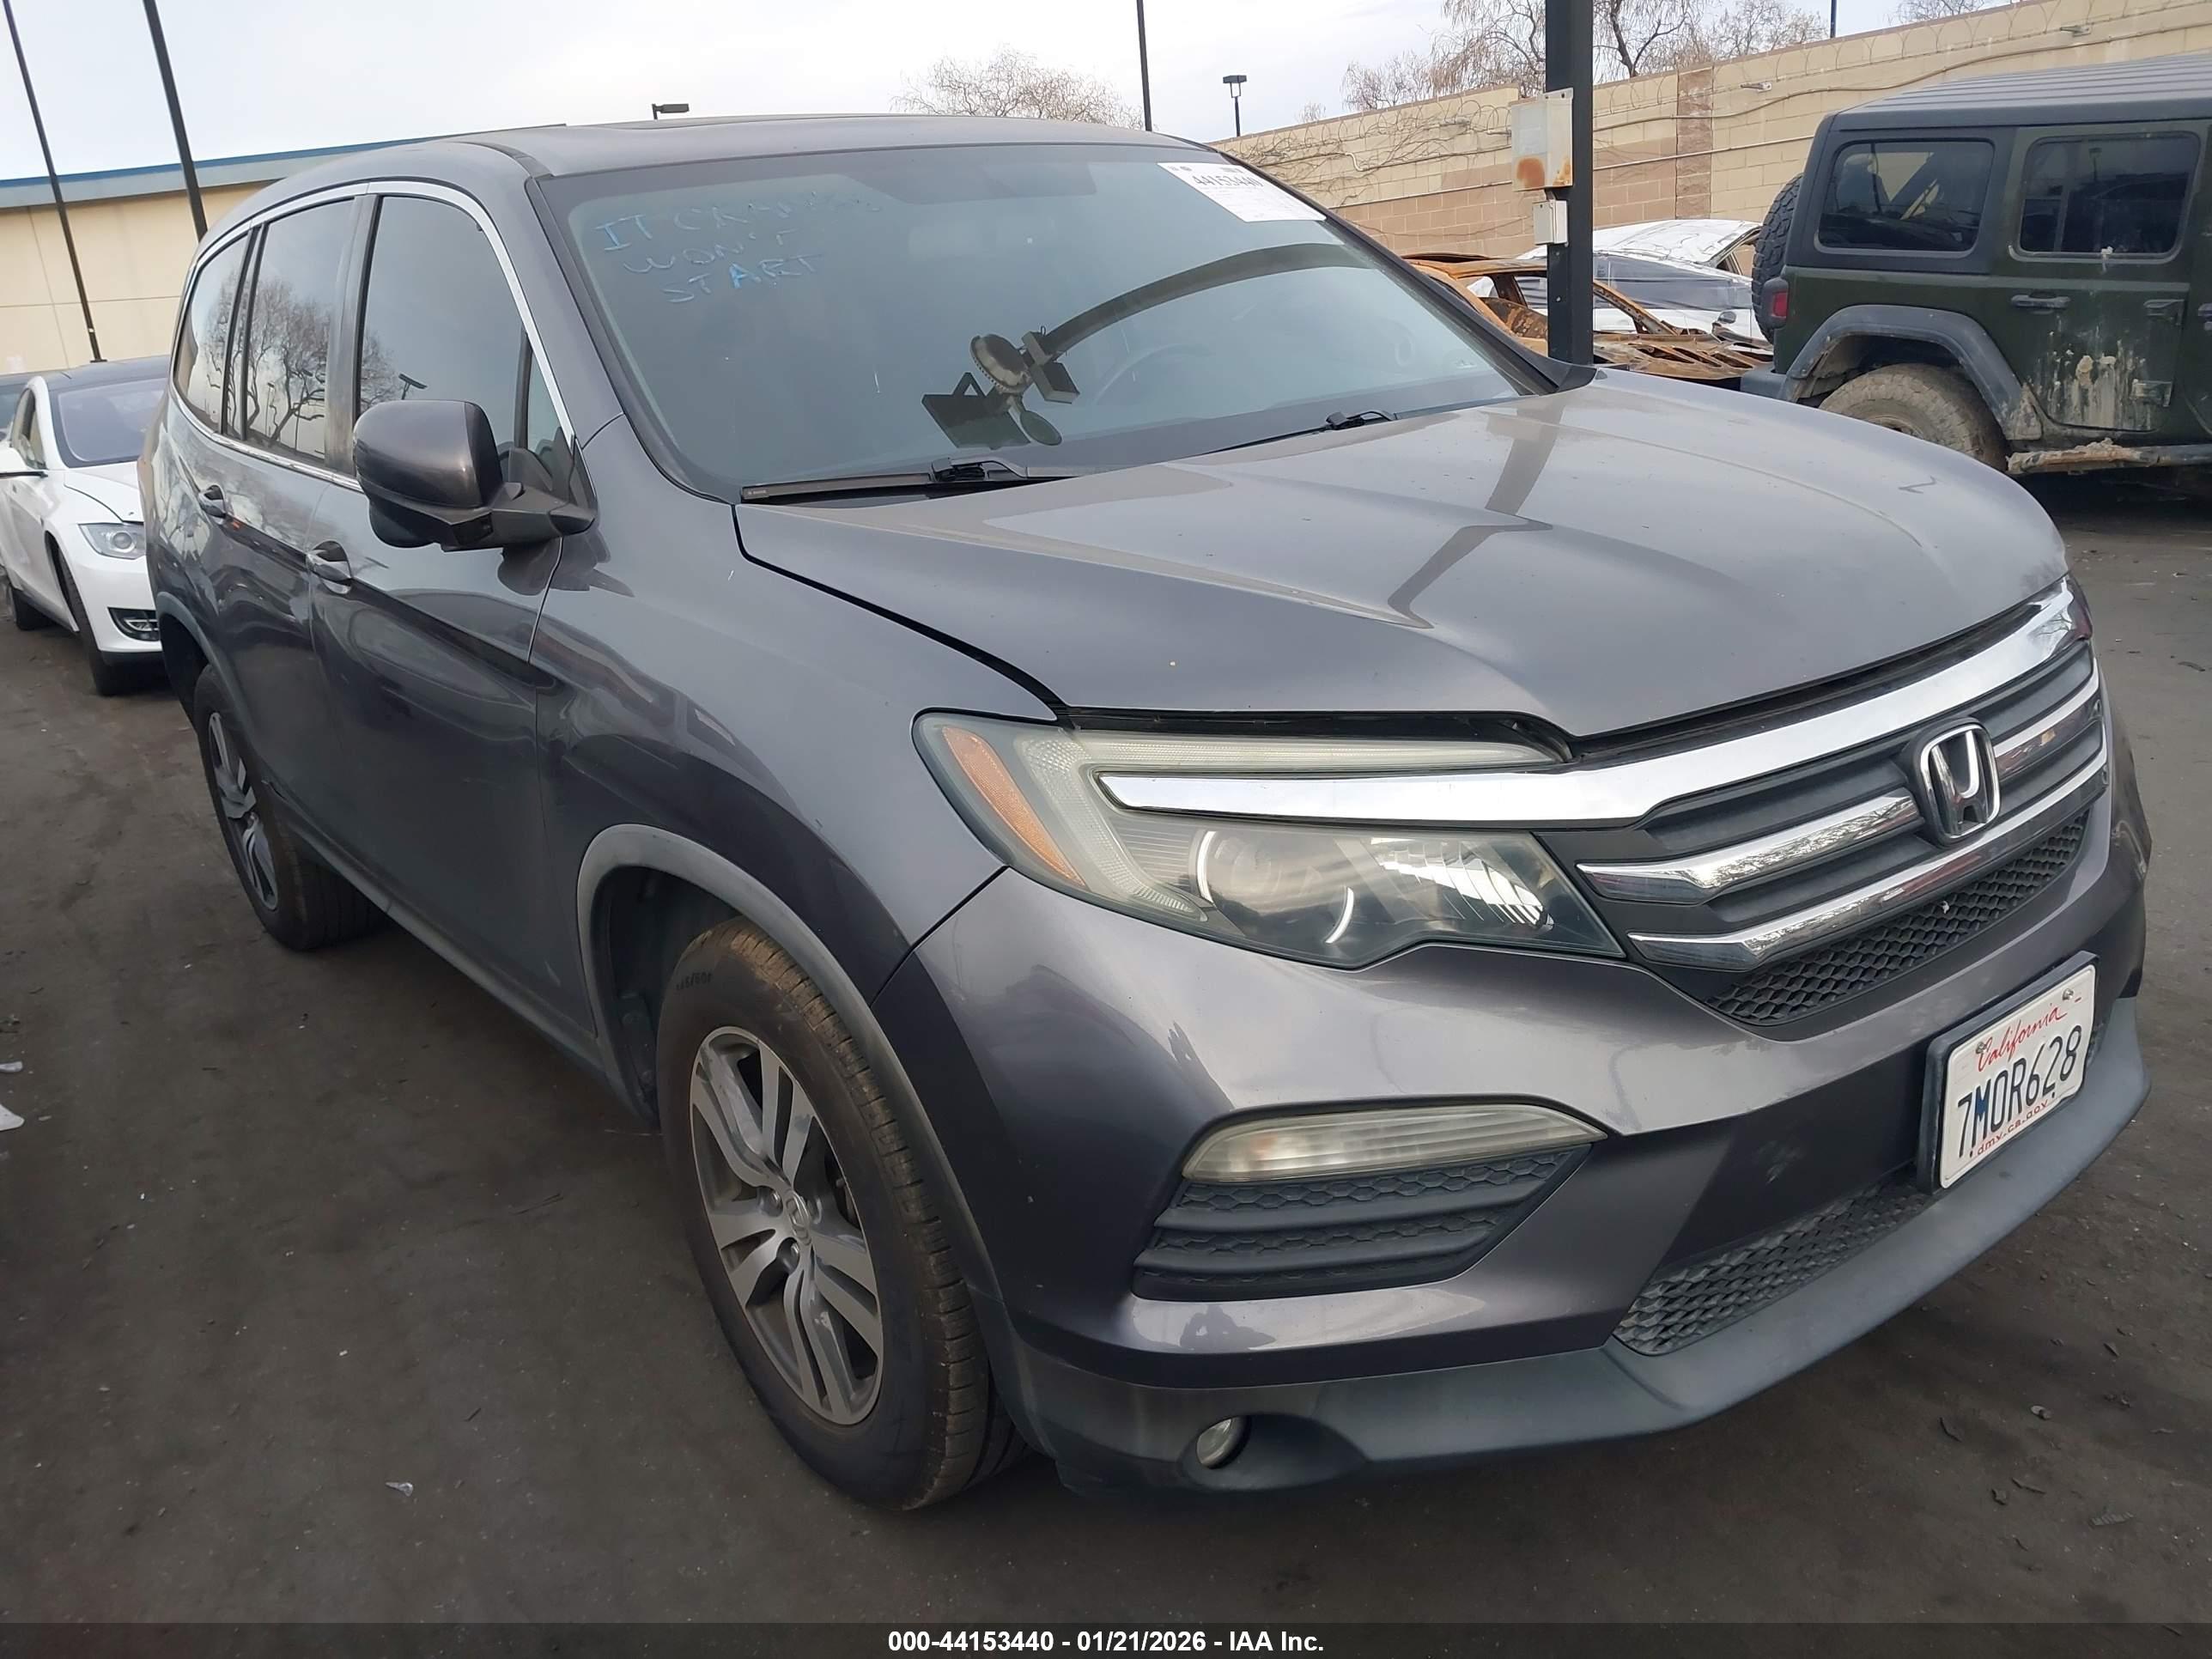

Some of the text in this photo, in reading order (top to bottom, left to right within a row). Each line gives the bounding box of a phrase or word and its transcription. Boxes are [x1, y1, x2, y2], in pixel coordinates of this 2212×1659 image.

[593, 213, 653, 252] IT
[1978, 1002, 2068, 1073] California
[1957, 1024, 2082, 1158] 7MOR628
